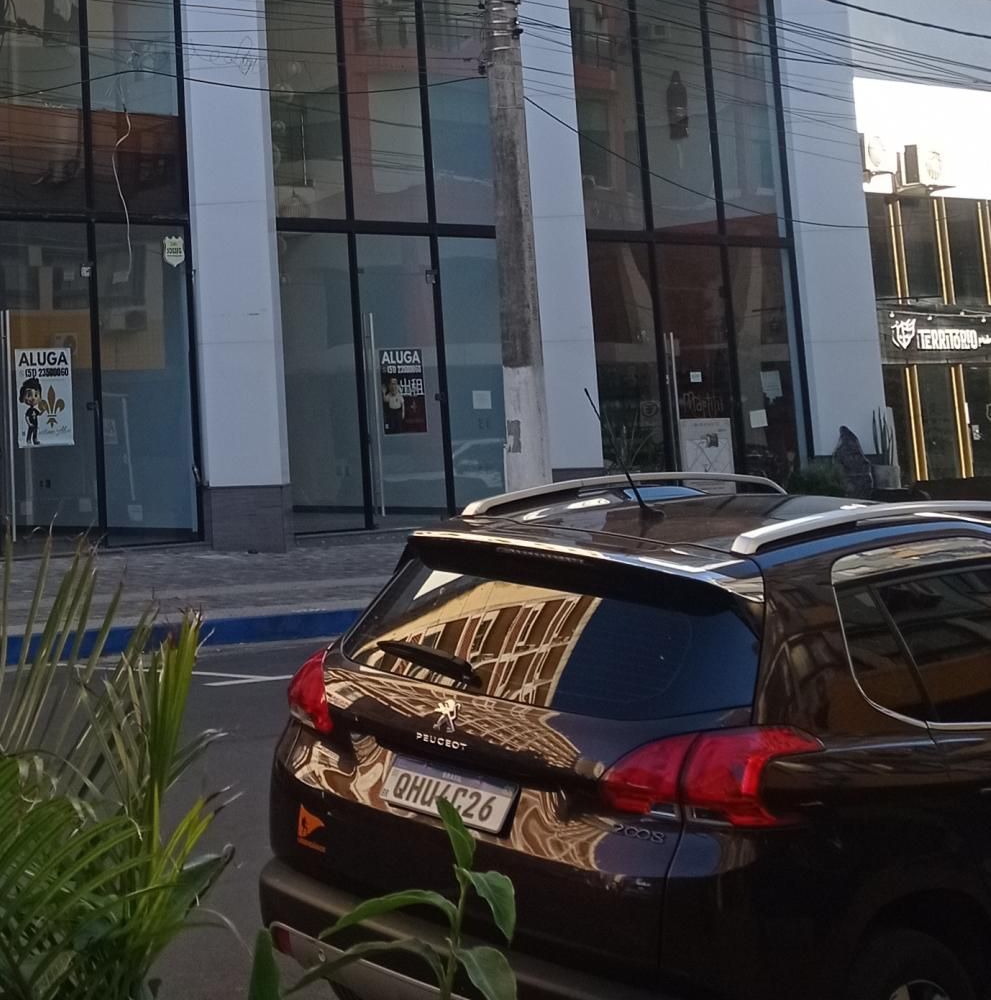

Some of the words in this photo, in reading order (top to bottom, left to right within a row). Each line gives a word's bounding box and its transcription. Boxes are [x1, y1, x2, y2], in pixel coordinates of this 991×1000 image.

[19, 351, 68, 366] ALUGA
[381, 351, 421, 364] ALUGA
[416, 732, 468, 750] PEUGEOT
